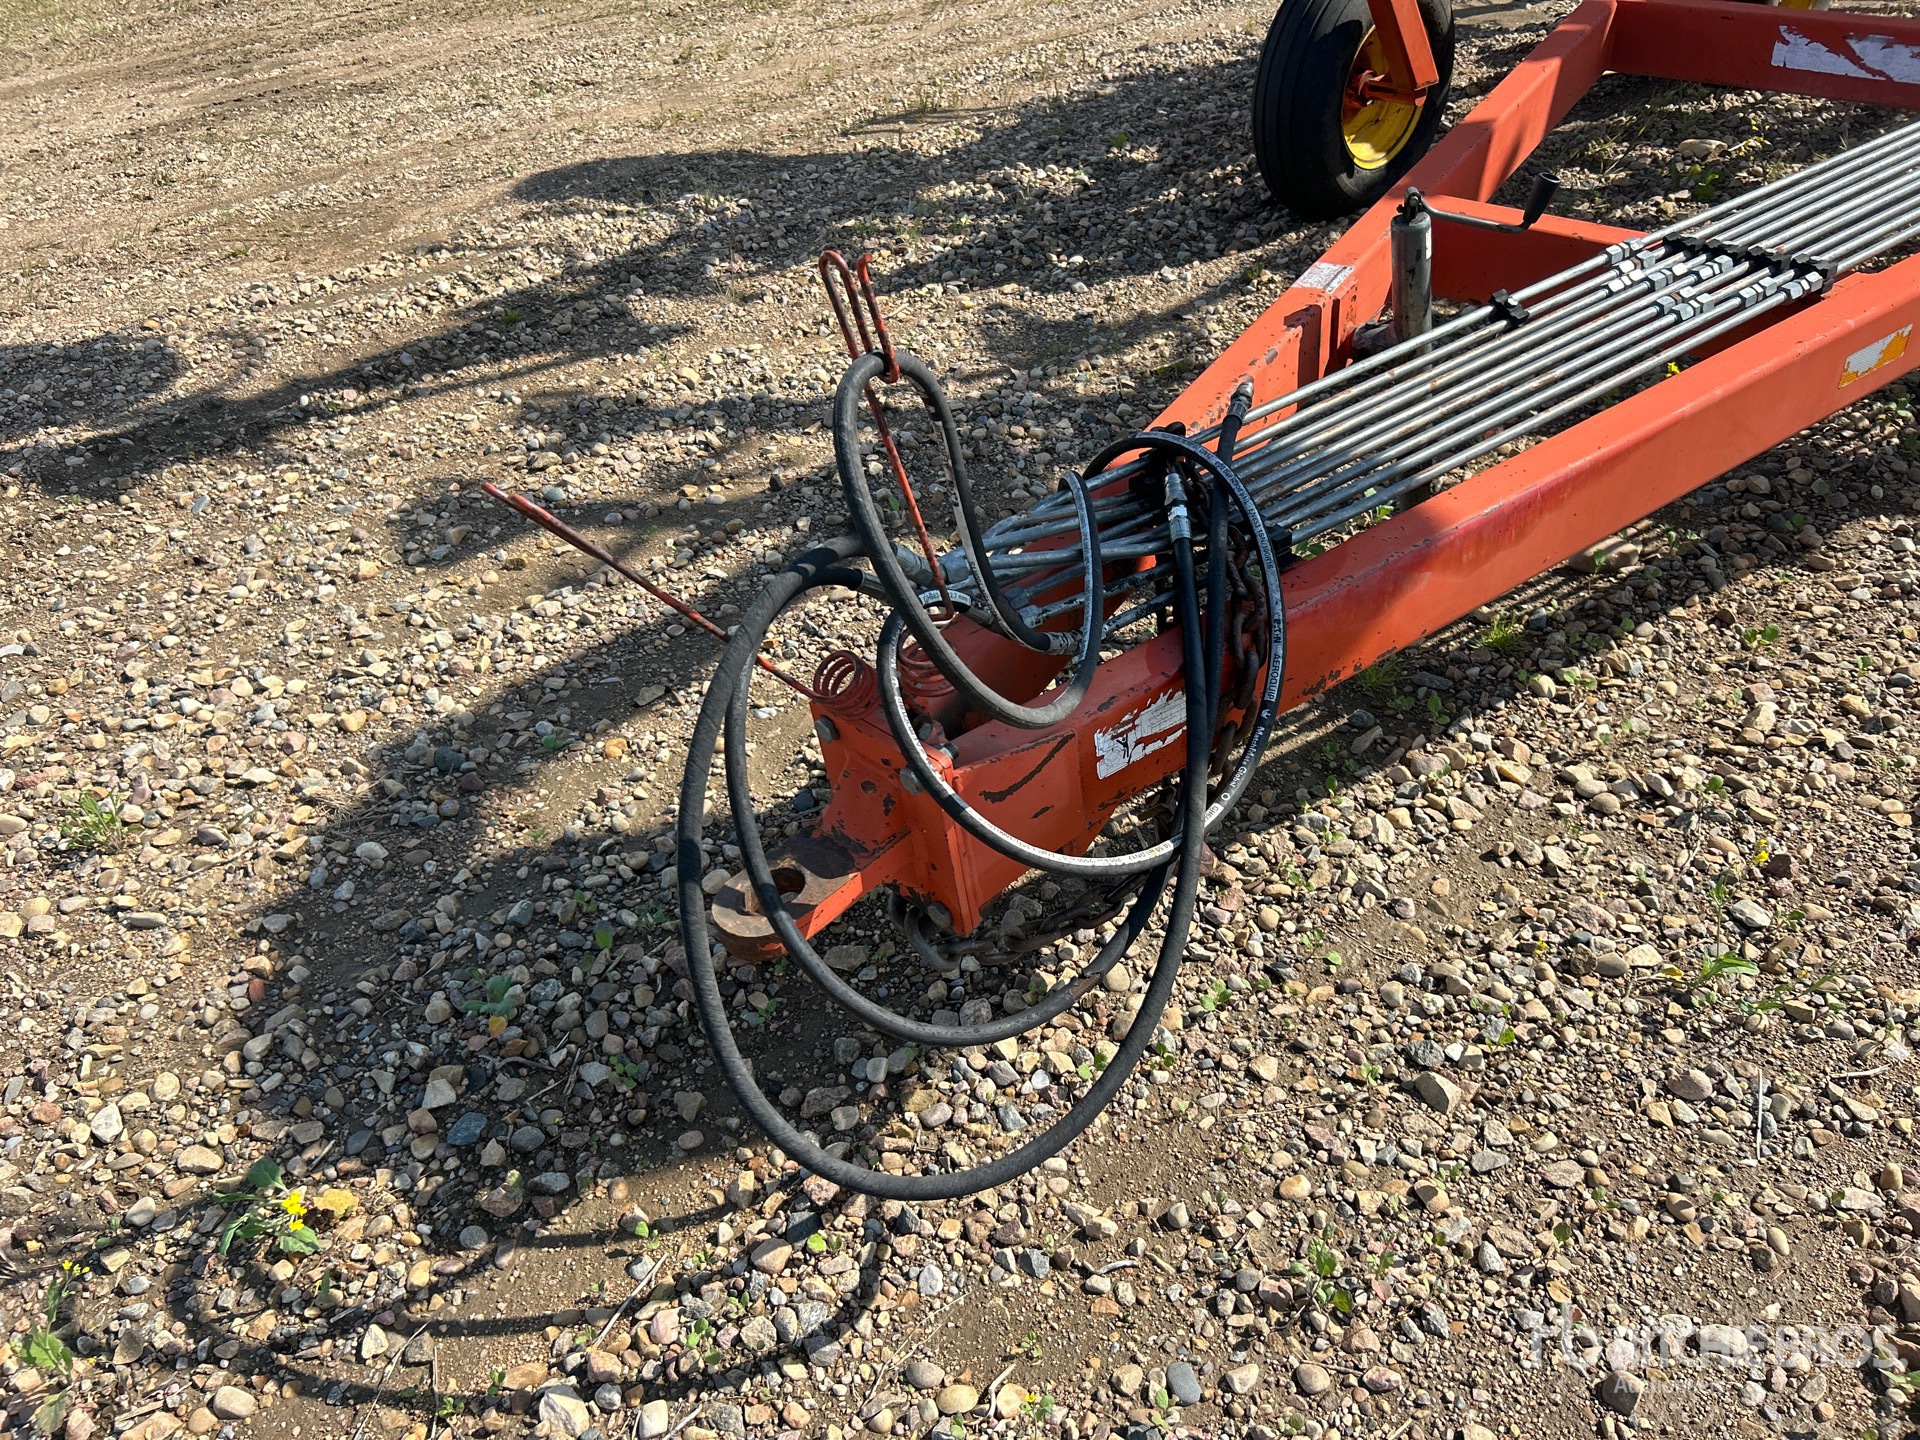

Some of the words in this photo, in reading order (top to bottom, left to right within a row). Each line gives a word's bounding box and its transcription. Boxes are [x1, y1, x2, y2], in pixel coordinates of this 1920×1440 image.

[1269, 653, 1281, 700] AEROQUIP
[1241, 726, 1265, 766] MatchMate
[1229, 766, 1247, 788] Global
